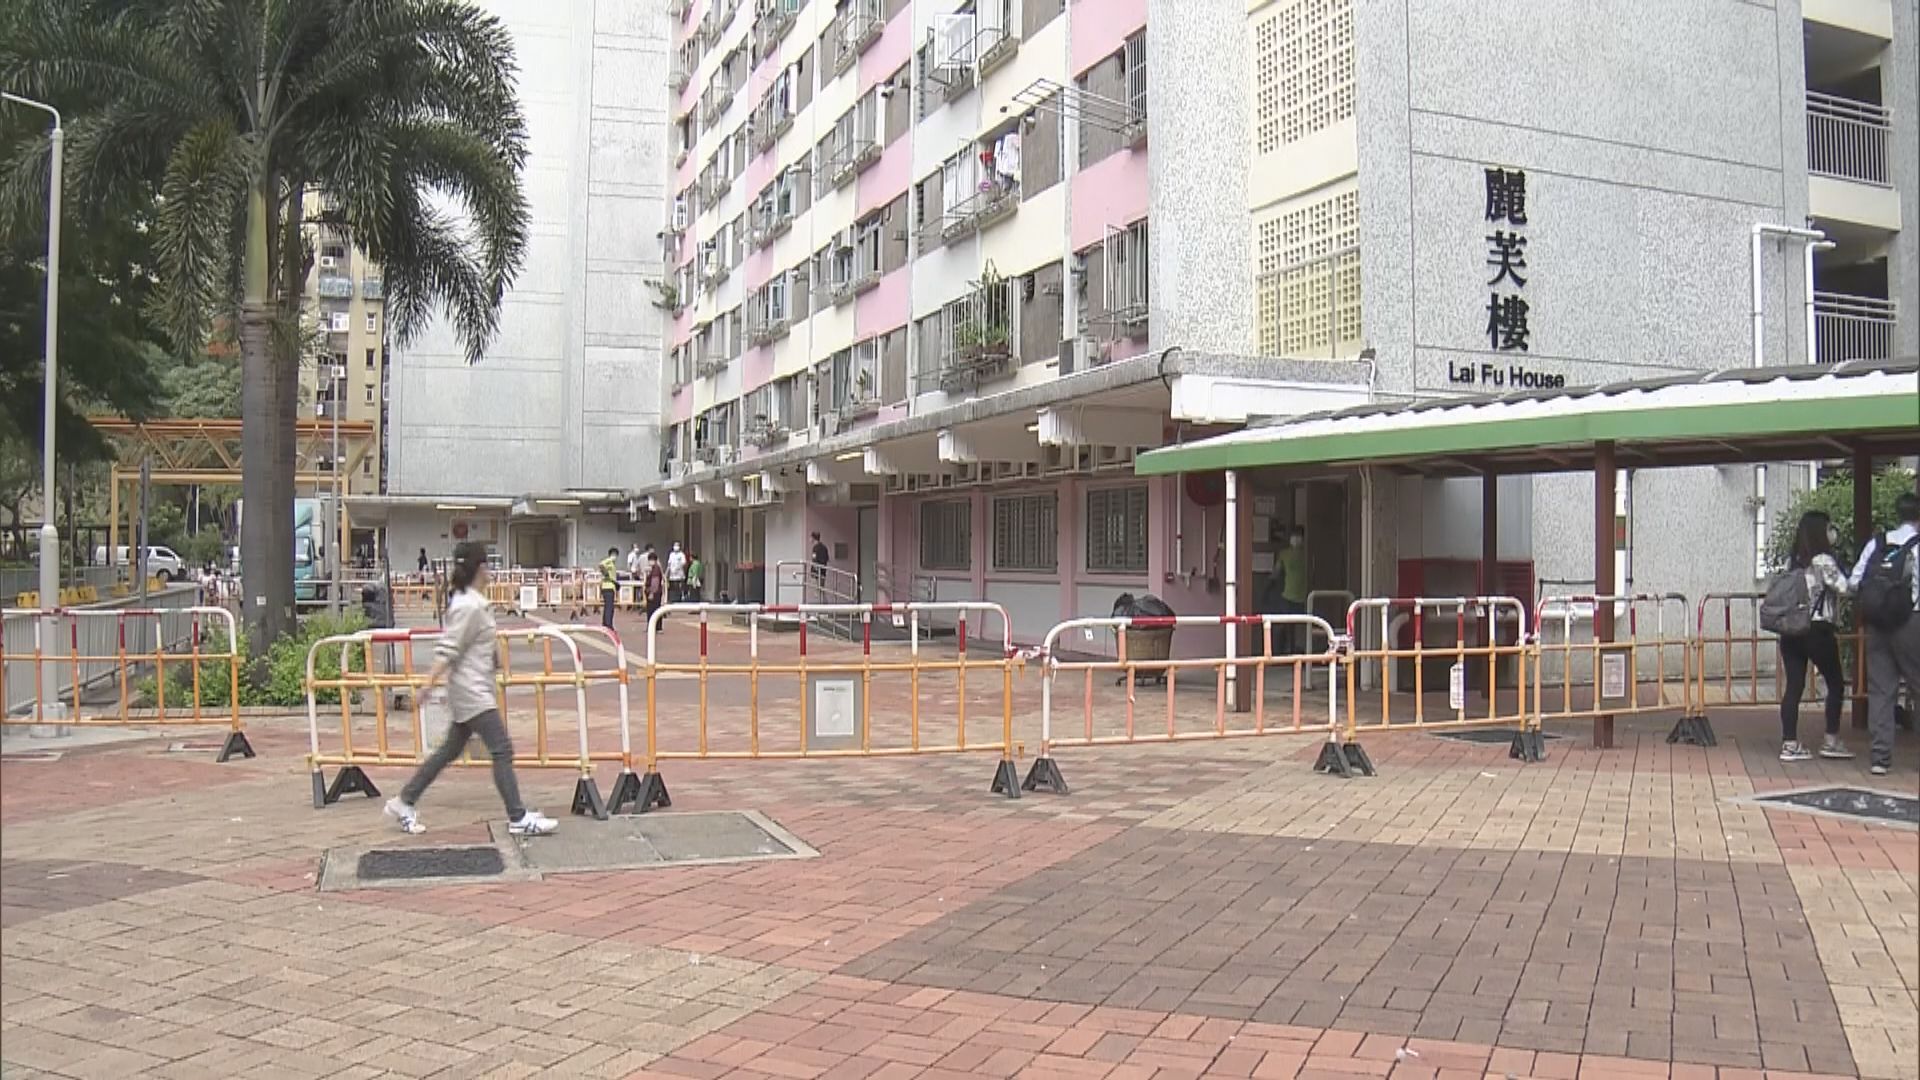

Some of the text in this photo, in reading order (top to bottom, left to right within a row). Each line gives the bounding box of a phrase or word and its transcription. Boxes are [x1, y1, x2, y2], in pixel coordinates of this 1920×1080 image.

[1484, 167, 1530, 352] 麗芙樓
[1448, 360, 1565, 389] Lai Fu House
